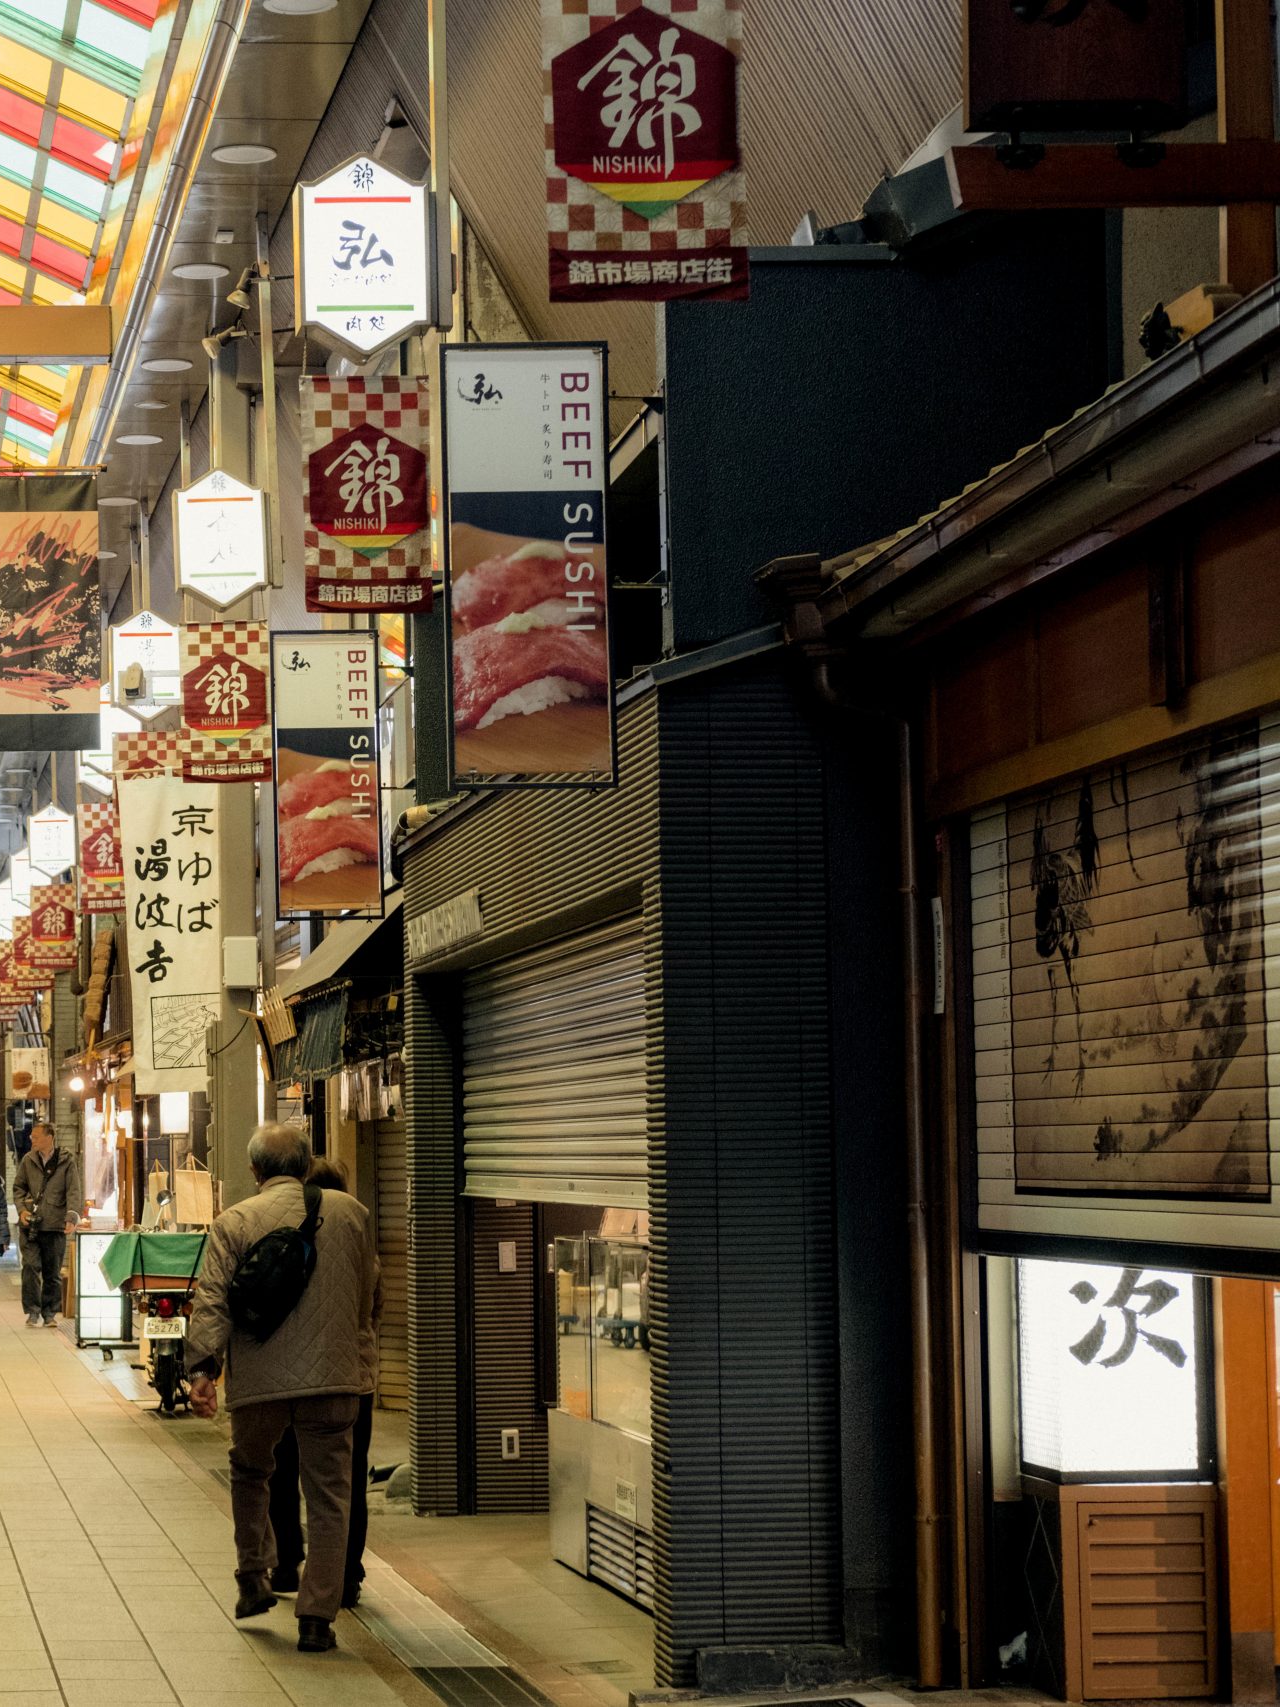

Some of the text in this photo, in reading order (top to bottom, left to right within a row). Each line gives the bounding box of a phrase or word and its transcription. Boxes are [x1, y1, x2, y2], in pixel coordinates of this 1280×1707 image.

[577, 27, 702, 179] 錦
[348, 163, 374, 192] 錦
[593, 155, 661, 173] NISHIKI
[332, 220, 394, 270] 弘
[568, 258, 733, 284] 錦市場商店街
[324, 437, 404, 533] 錦
[561, 373, 595, 630] BEEF SUSHI
[334, 518, 379, 530] NISHIKI
[318, 585, 422, 603] 錦市場商店街
[195, 661, 251, 728] 錦
[201, 717, 233, 726] NISHIKI
[348, 650, 370, 819] BEEF SUSHI
[191, 762, 264, 776] 錦市場商店街
[171, 804, 220, 934] 京ゆば
[37, 906, 66, 938] 錦
[135, 838, 176, 983] 湯波吉
[154, 1323, 180, 1333] 5278
[1068, 1267, 1188, 1368] 次
